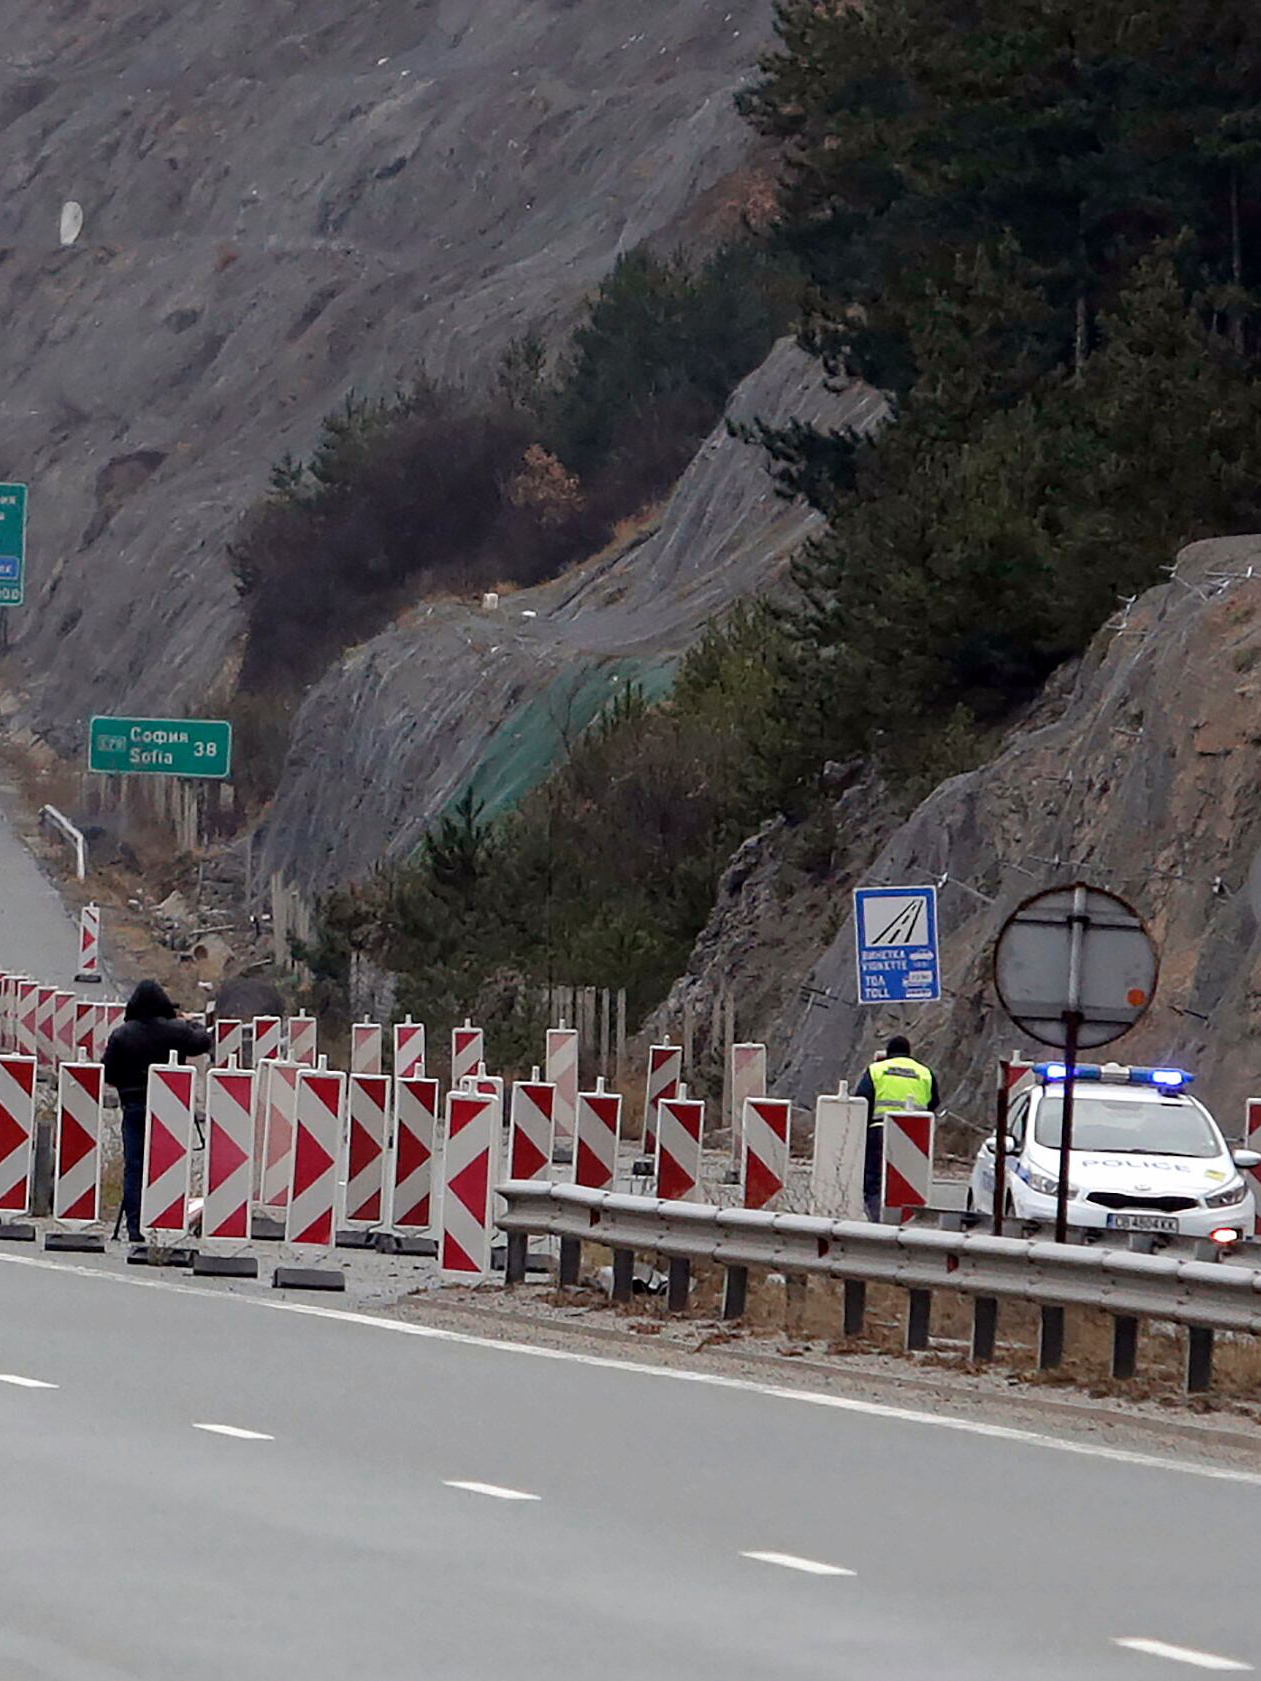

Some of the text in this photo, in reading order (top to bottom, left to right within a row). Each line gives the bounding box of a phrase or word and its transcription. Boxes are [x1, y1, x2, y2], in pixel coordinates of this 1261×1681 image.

[130, 726, 189, 744] София
[130, 748, 173, 764] Sofia
[194, 742, 217, 757] 38
[1082, 1160, 1191, 1173] POLICE
